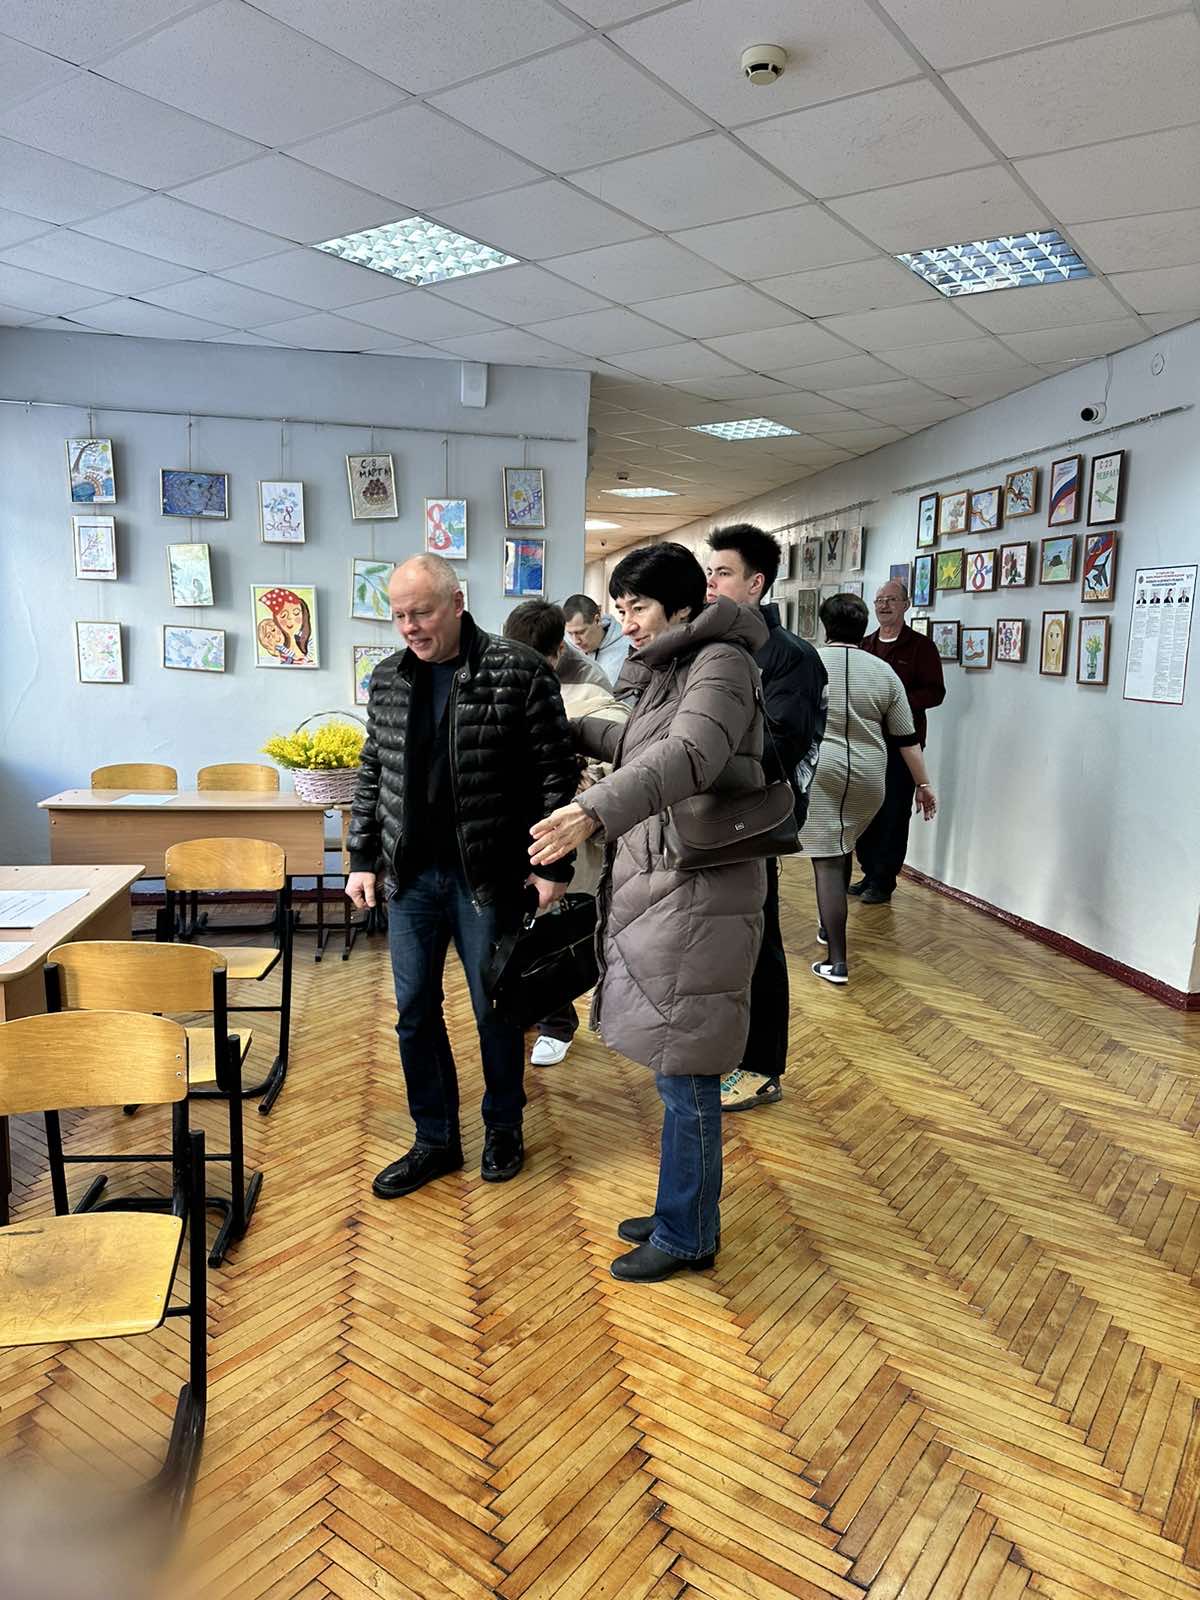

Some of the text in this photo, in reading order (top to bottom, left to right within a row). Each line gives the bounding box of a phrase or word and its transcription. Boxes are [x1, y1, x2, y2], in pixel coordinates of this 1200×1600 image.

[361, 459, 367, 469] С
[427, 503, 452, 550] 8
[972, 553, 986, 592] 8
